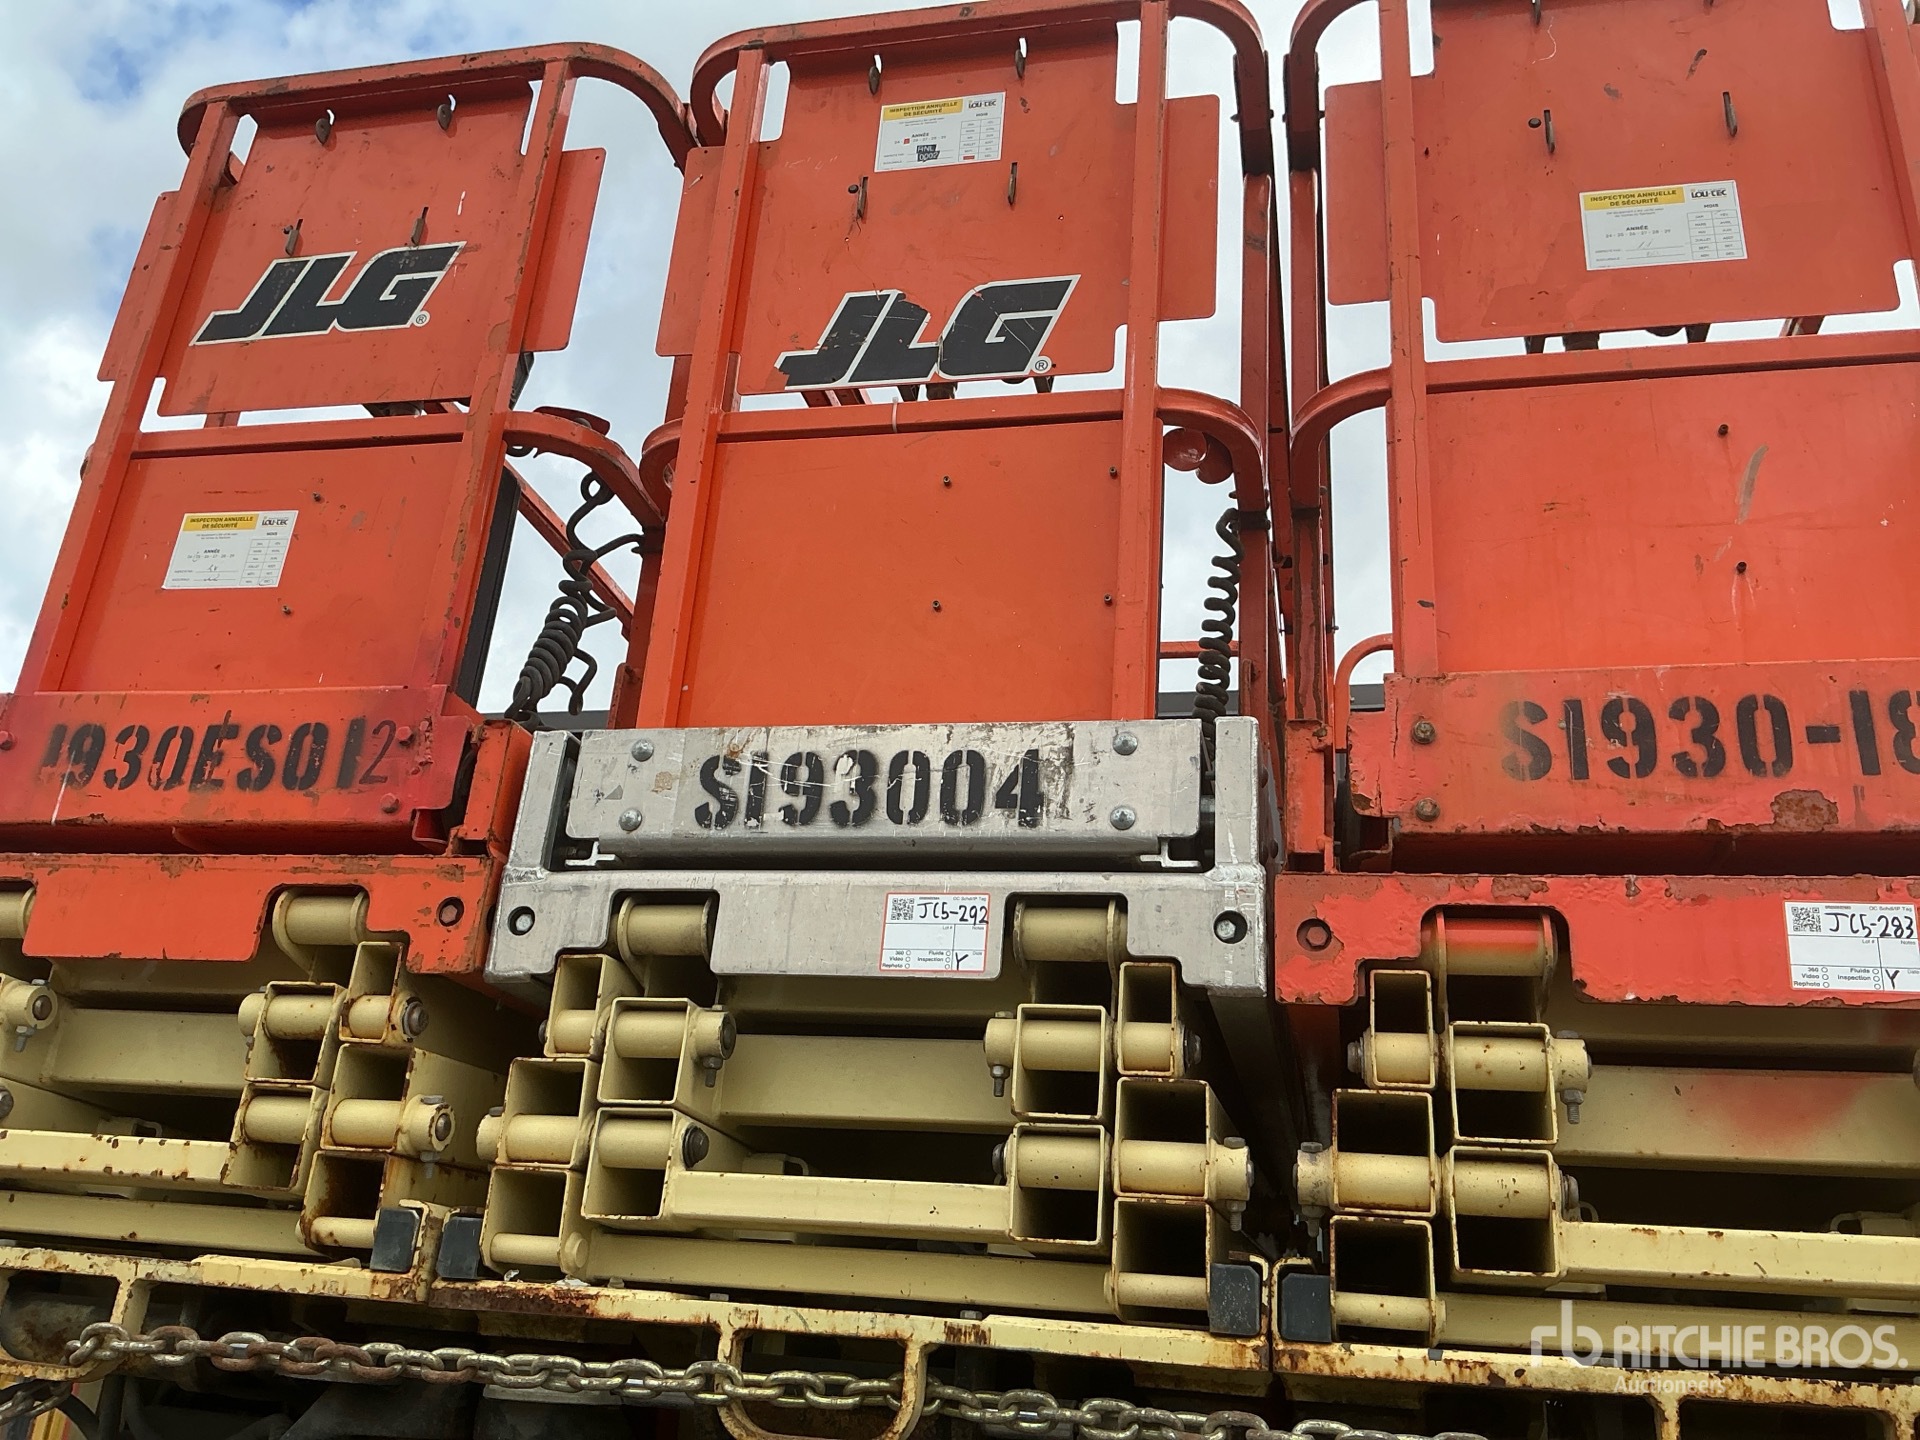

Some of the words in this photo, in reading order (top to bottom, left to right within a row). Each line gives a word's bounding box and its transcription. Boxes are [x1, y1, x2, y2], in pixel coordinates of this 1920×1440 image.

[889, 105, 925, 113] INSPECTION
[926, 101, 958, 109] ANNUELLE
[1591, 193, 1635, 202] INSPECTION
[1637, 189, 1677, 198] ANNUELLE
[1622, 197, 1659, 206] SÉCURITÉ
[189, 241, 467, 346] JLG
[773, 274, 1081, 390] JLG
[694, 749, 1045, 829] S193004
